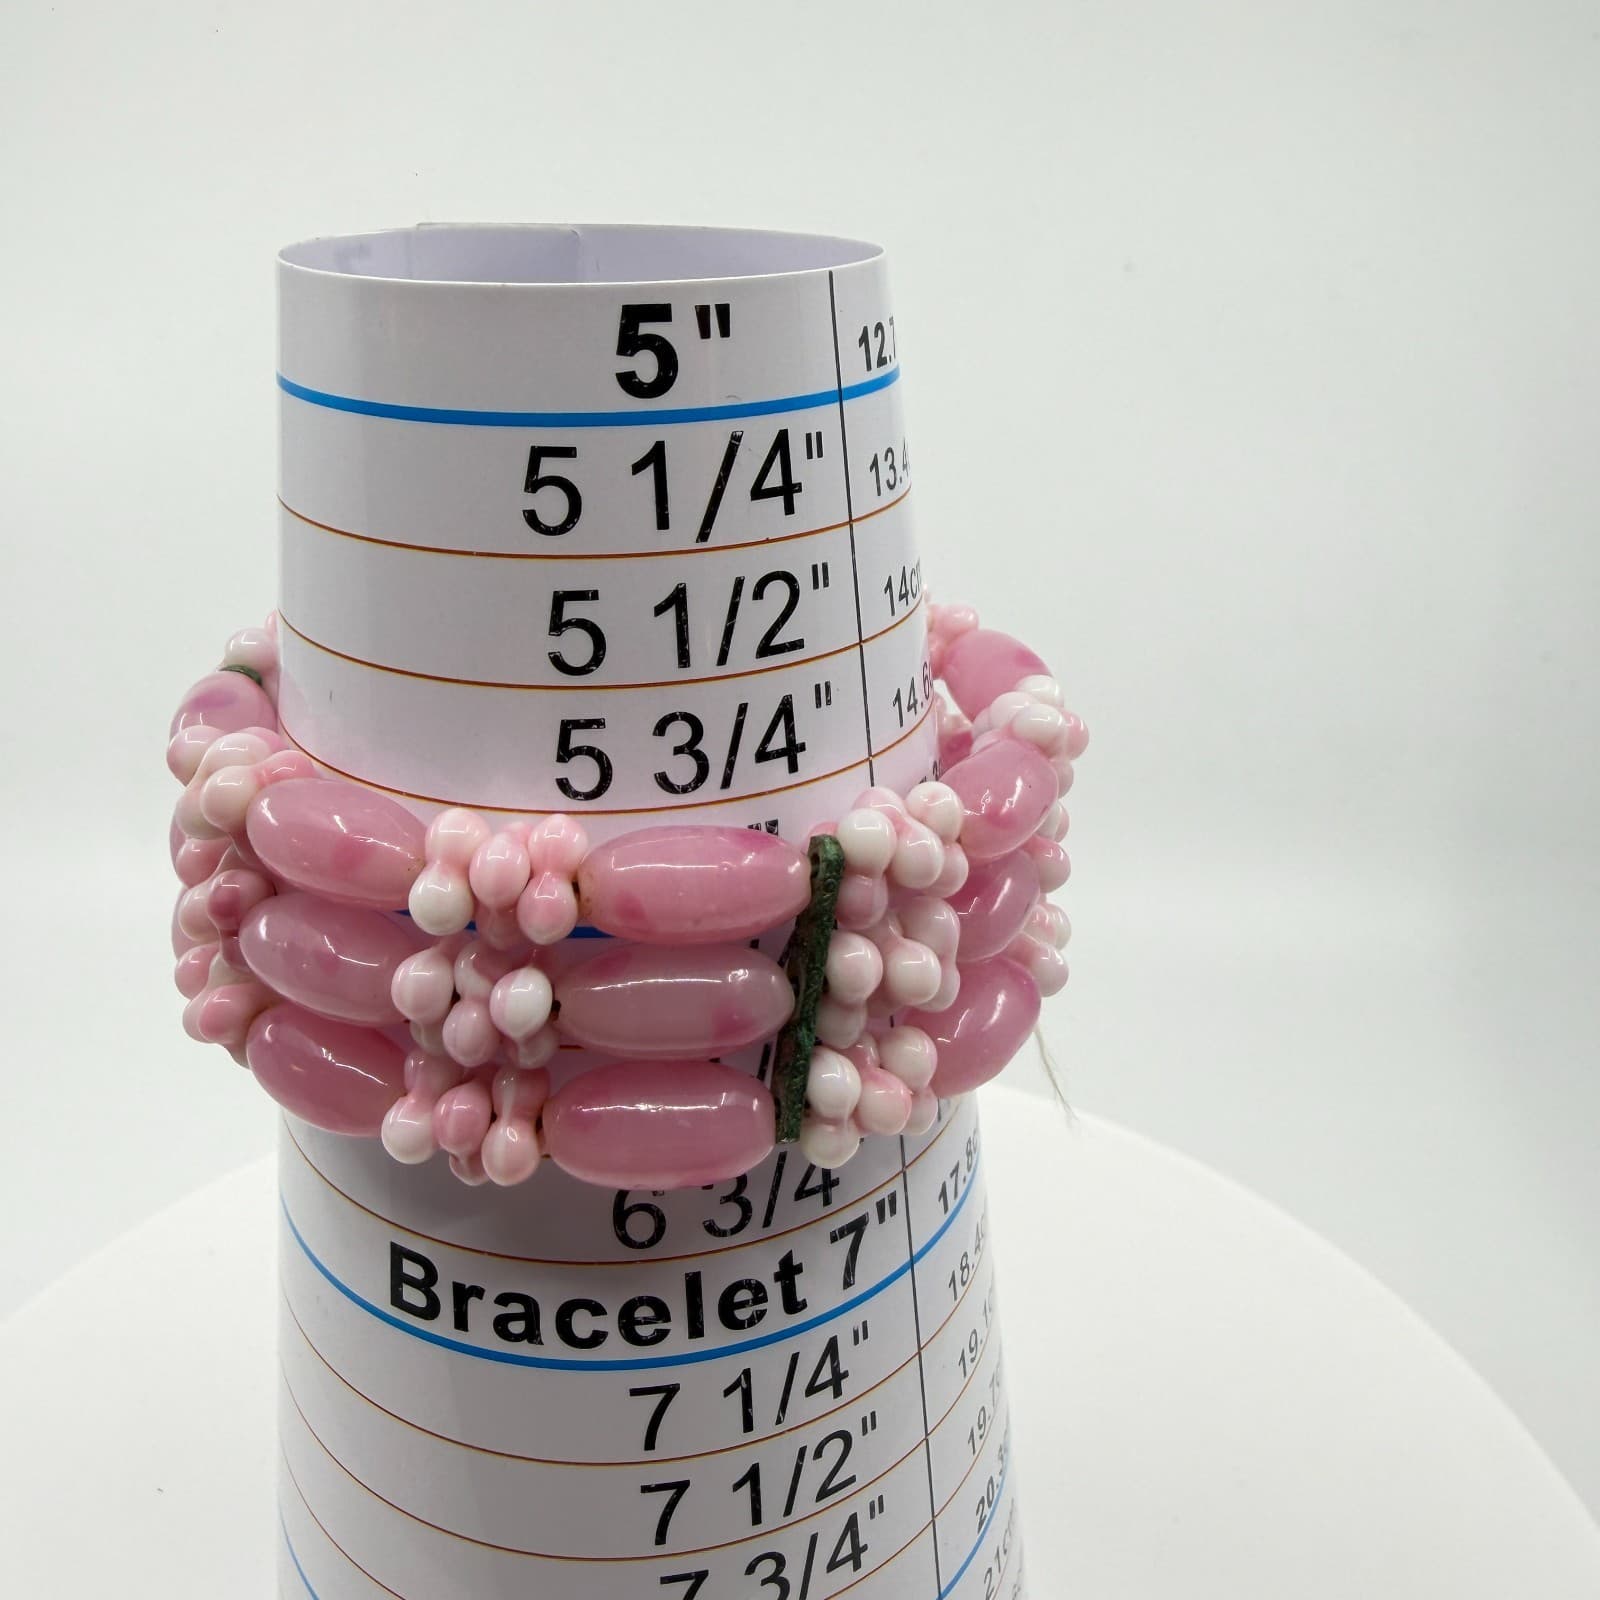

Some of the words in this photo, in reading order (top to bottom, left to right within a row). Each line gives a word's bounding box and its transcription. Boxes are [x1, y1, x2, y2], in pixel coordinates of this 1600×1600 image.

[615, 302, 732, 400] 5"
[522, 444, 583, 537] 5
[630, 428, 824, 543] 1/4"
[547, 588, 608, 677] 5
[653, 561, 830, 669] 1/2"
[555, 717, 614, 801] 5
[651, 680, 833, 795] 3/4"
[388, 1241, 808, 1350] Bracelet
[829, 1190, 898, 1290] 7"
[628, 1382, 681, 1452] 7
[722, 1319, 869, 1426] 1/4"
[640, 1479, 691, 1546] 7
[731, 1410, 878, 1527] 1/2"
